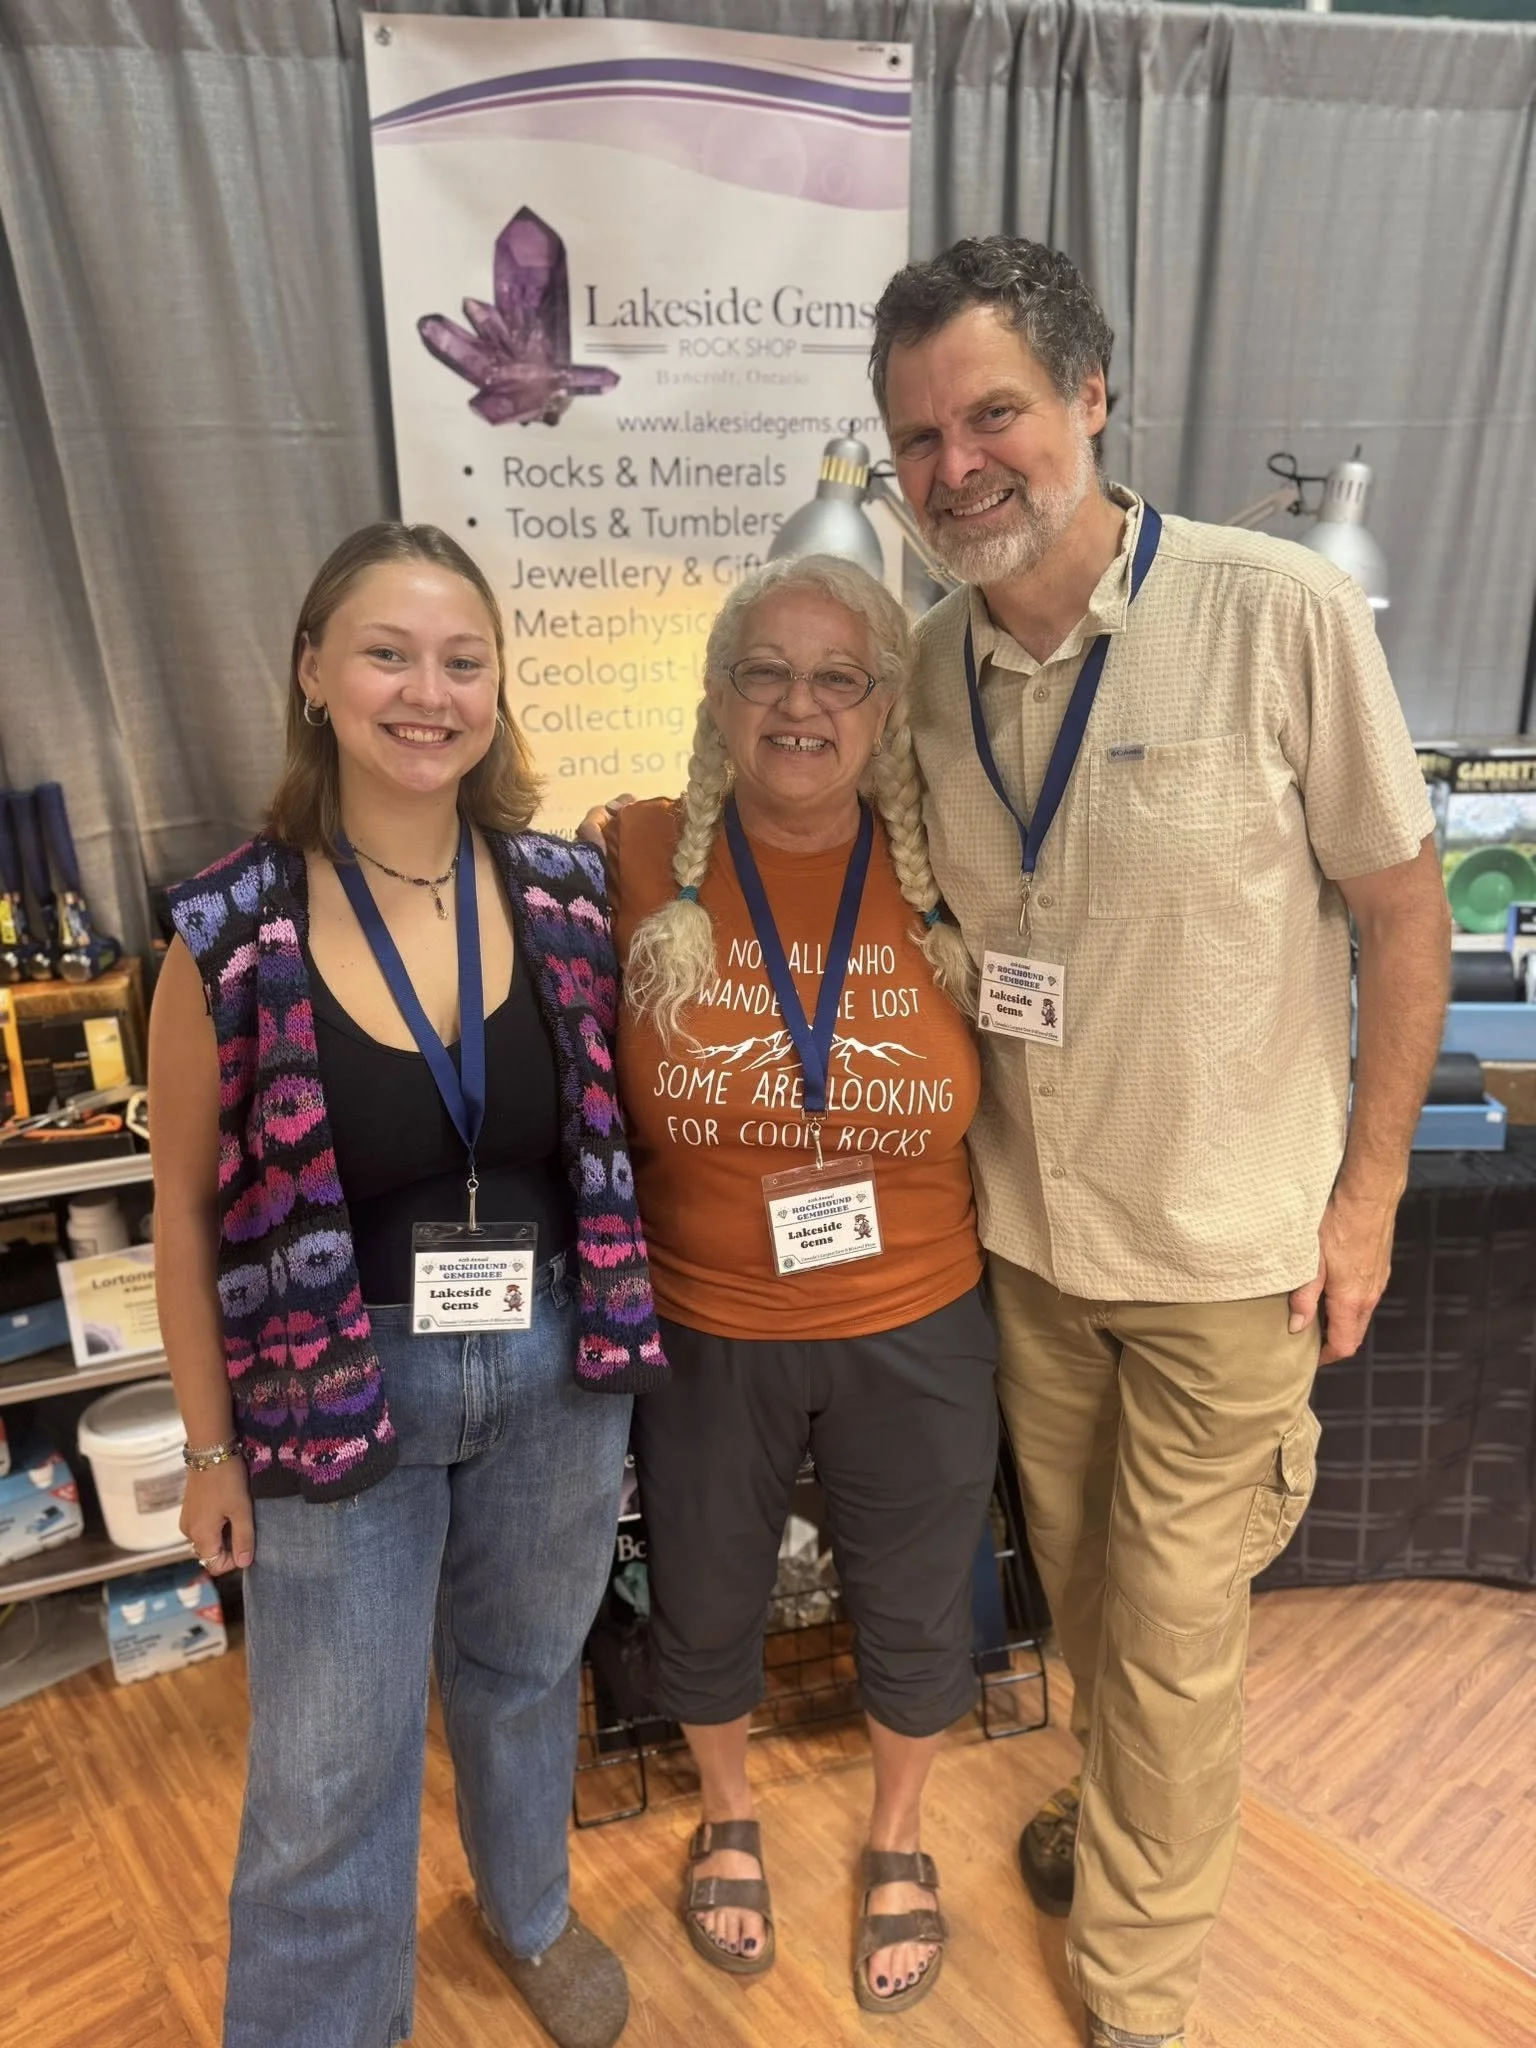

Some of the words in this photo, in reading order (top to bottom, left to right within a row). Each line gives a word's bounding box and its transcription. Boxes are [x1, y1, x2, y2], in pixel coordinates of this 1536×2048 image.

[585, 285, 763, 327] Lakeside
[772, 285, 877, 328] Gems
[679, 337, 741, 358] ROCK
[744, 337, 798, 358] SHOP
[745, 369, 809, 386] Ontario
[616, 410, 886, 439] www.lakesidegems.com
[502, 456, 604, 488] Rocks
[615, 456, 639, 488] &
[650, 455, 787, 488] Minerals
[505, 507, 597, 539] Tools
[608, 507, 631, 538] &
[641, 506, 783, 538] Tumblers
[511, 557, 672, 597] Jewellery
[682, 556, 703, 587] &
[514, 607, 711, 645] Metaphysic
[521, 703, 684, 735] Collecting
[558, 747, 620, 777] and
[631, 752, 666, 774] so
[728, 938, 768, 970] NO
[788, 941, 825, 975] ALL
[848, 943, 895, 975] WHO
[997, 965, 1044, 981] ROCKHOUND
[999, 975, 1040, 990] GEMBOREE
[697, 977, 799, 1018] WANDE
[872, 989, 919, 1018] LOST
[989, 989, 1032, 1006] Lakeside
[996, 1004, 1023, 1017] Gems
[654, 1061, 733, 1105] SOME
[751, 1071, 803, 1109] ARE
[827, 1078, 953, 1115] LOOKING
[667, 1116, 720, 1147] FOR
[739, 1120, 821, 1150] COOL
[838, 1125, 932, 1157] ROCKS
[792, 1196, 852, 1214] ROCKHOUND
[797, 1204, 849, 1221] GEMBOREE
[788, 1221, 842, 1240] Lakeside
[800, 1236, 834, 1249] Gems
[439, 1262, 507, 1271] ROCKHOUND
[443, 1271, 503, 1280] GEMBOREE
[430, 1286, 492, 1299] Lakeside
[442, 1302, 479, 1311] Gems
